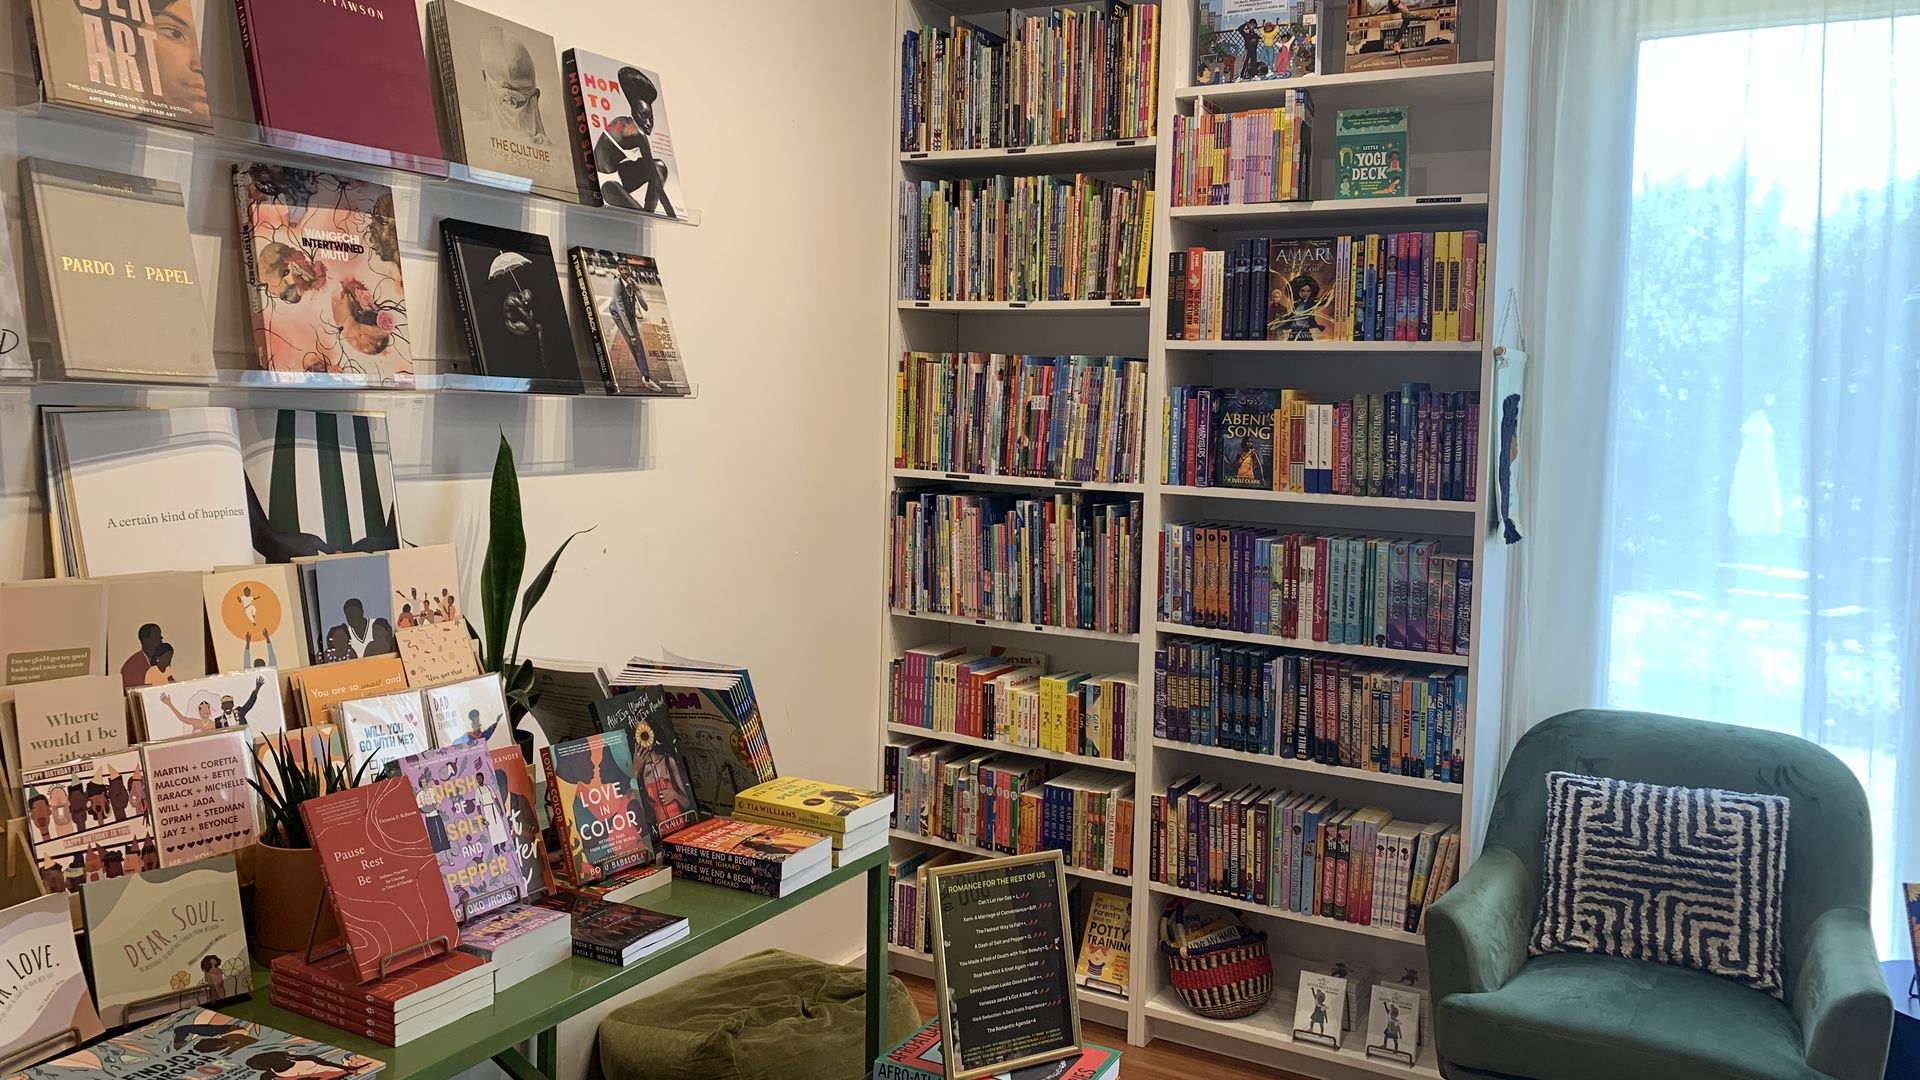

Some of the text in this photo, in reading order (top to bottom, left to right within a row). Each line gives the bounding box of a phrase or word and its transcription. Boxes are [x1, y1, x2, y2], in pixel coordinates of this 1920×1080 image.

[83, 14, 163, 97] ART
[587, 94, 611, 111] TO
[490, 137, 509, 151] THE
[510, 139, 550, 162] CULTURE
[1355, 152, 1387, 166] YOGI
[1352, 166, 1388, 181] DECK
[304, 227, 360, 244] WANGECHI
[301, 237, 365, 255] INTERTWINED
[320, 248, 349, 263] MUTU
[1276, 248, 1333, 264] AMARI
[61, 256, 115, 277] PARDO
[145, 266, 194, 286] PAPEL
[578, 278, 589, 307] BEFORE
[585, 307, 597, 333] CRACK
[1222, 412, 1276, 428] ABENI'S
[1227, 426, 1271, 440] SONG
[107, 506, 245, 529] A certain kind of happiness
[311, 687, 330, 698] You
[332, 686, 347, 694] are
[385, 674, 402, 685] and
[425, 674, 440, 682] You
[433, 696, 449, 712] DAD
[1299, 697, 1307, 726] RHYTHM
[46, 711, 99, 727] Where
[386, 722, 404, 734] YOU
[30, 726, 117, 750] would I be
[359, 739, 372, 752] GO
[399, 733, 415, 745] ME?
[1298, 736, 1306, 753] TIME
[153, 756, 238, 778] MARTIN CORETTA
[446, 764, 455, 775] A
[155, 768, 236, 790] MALCOLM BETTY
[542, 752, 563, 823] LOVE COLOR
[157, 778, 245, 802] BARACK MICHELLE
[432, 780, 477, 802] DASH
[580, 782, 623, 808] LOVE
[158, 797, 215, 814] WILL JADA
[160, 802, 245, 827] OPRAH STEDMAN
[454, 802, 467, 815] OF
[600, 804, 610, 816] IN
[758, 805, 797, 820] WILLIAMS
[162, 815, 238, 839] JAY Z BEYONCE
[446, 816, 485, 842] SALT
[580, 811, 638, 840] COLOR
[333, 847, 366, 862] Pause
[462, 843, 483, 858] AND
[675, 845, 756, 867] WHERE WE END & BEGIN
[360, 856, 385, 871] Rest
[611, 853, 645, 870] BABALOLA
[698, 857, 741, 871] JANE IGHARO
[357, 875, 373, 886] Be
[447, 858, 509, 888] PEPPER
[676, 862, 698, 874] WHERE
[699, 866, 710, 875] WE
[711, 869, 724, 878] END
[732, 872, 754, 885] BEGIN
[698, 875, 740, 889] JANE IGHARO
[948, 871, 1046, 894] ROMANCE FOR THE REST OF US
[1094, 908, 1121, 920] Parent's
[124, 930, 177, 968] DEAR,
[172, 900, 224, 931] SOUL.
[1088, 922, 1130, 940] POTTY
[1219, 929, 1237, 942] HAIR!
[7, 945, 60, 980] LOVE.
[122, 1050, 200, 1080] FIND JOY
